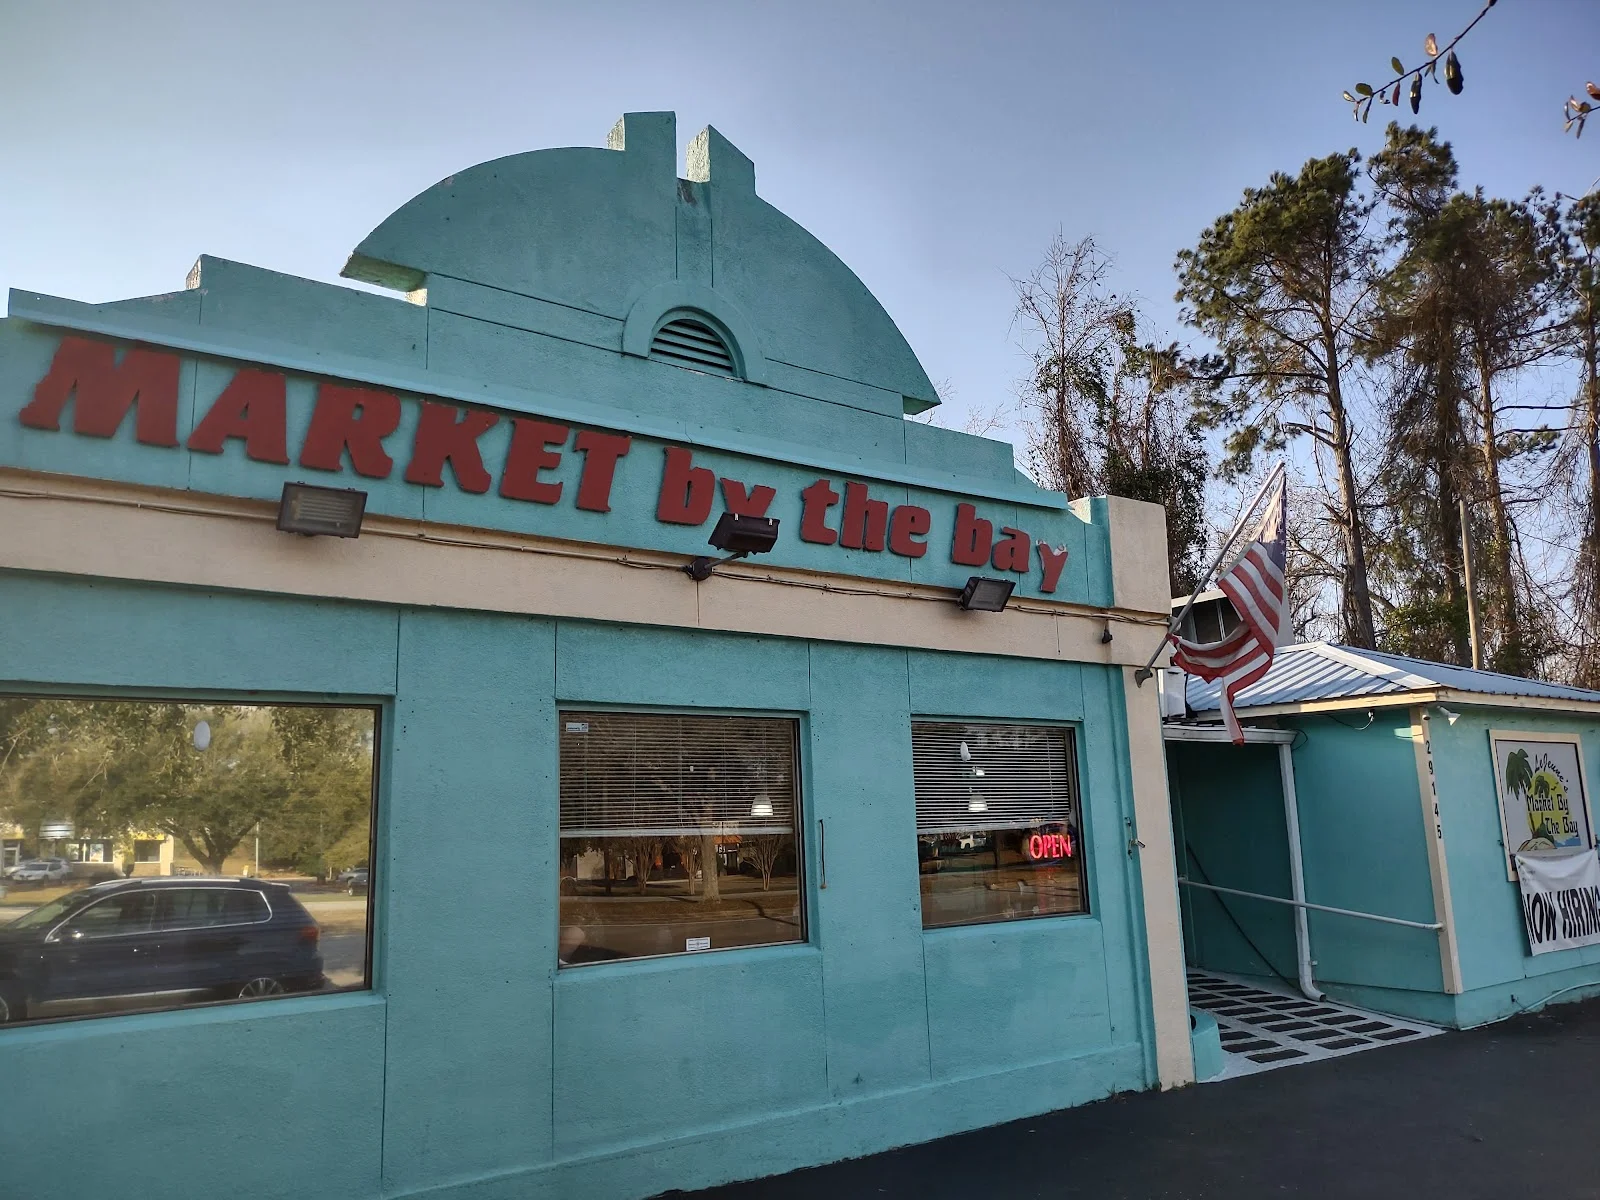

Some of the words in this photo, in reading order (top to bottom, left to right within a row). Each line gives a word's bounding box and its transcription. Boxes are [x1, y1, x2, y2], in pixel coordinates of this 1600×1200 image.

[19, 336, 631, 512] MARKET
[801, 479, 931, 558] the
[952, 503, 1068, 593] bay
[1425, 740, 1442, 839] 29145
[1526, 793, 1555, 812] Market
[1556, 793, 1570, 816] By
[1029, 834, 1072, 859] OPEN
[1545, 817, 1561, 835] The
[1562, 816, 1579, 838] Bay
[1522, 891, 1557, 946] NOW
